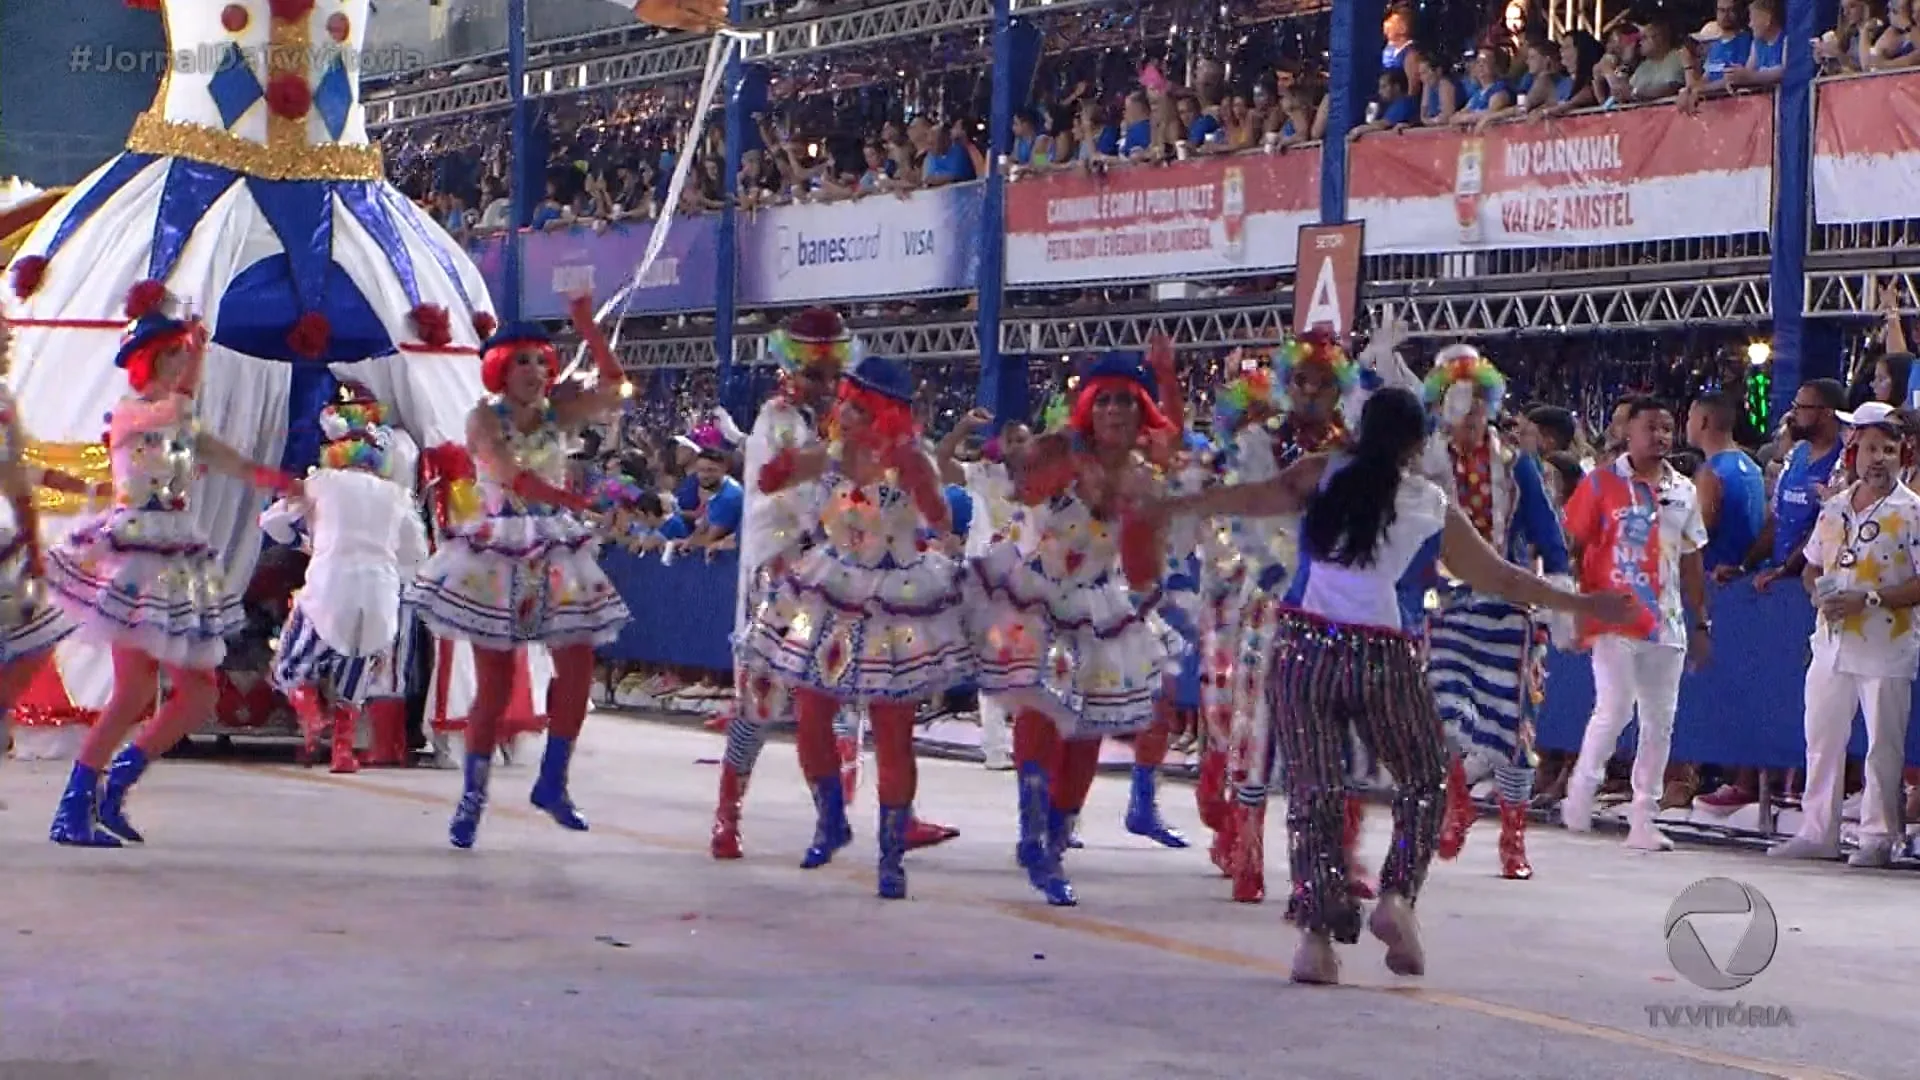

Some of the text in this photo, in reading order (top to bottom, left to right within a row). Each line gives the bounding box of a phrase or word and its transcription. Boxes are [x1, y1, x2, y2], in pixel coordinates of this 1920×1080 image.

[1505, 133, 1623, 177] NO CARNAVAL
[1136, 190, 1144, 216] A
[1178, 183, 1214, 213] MALTE
[1502, 192, 1635, 233] VAI DE AMSTEL
[798, 223, 935, 267] banescard VISA
[1315, 234, 1344, 249] SETOR
[1303, 255, 1343, 338] A
